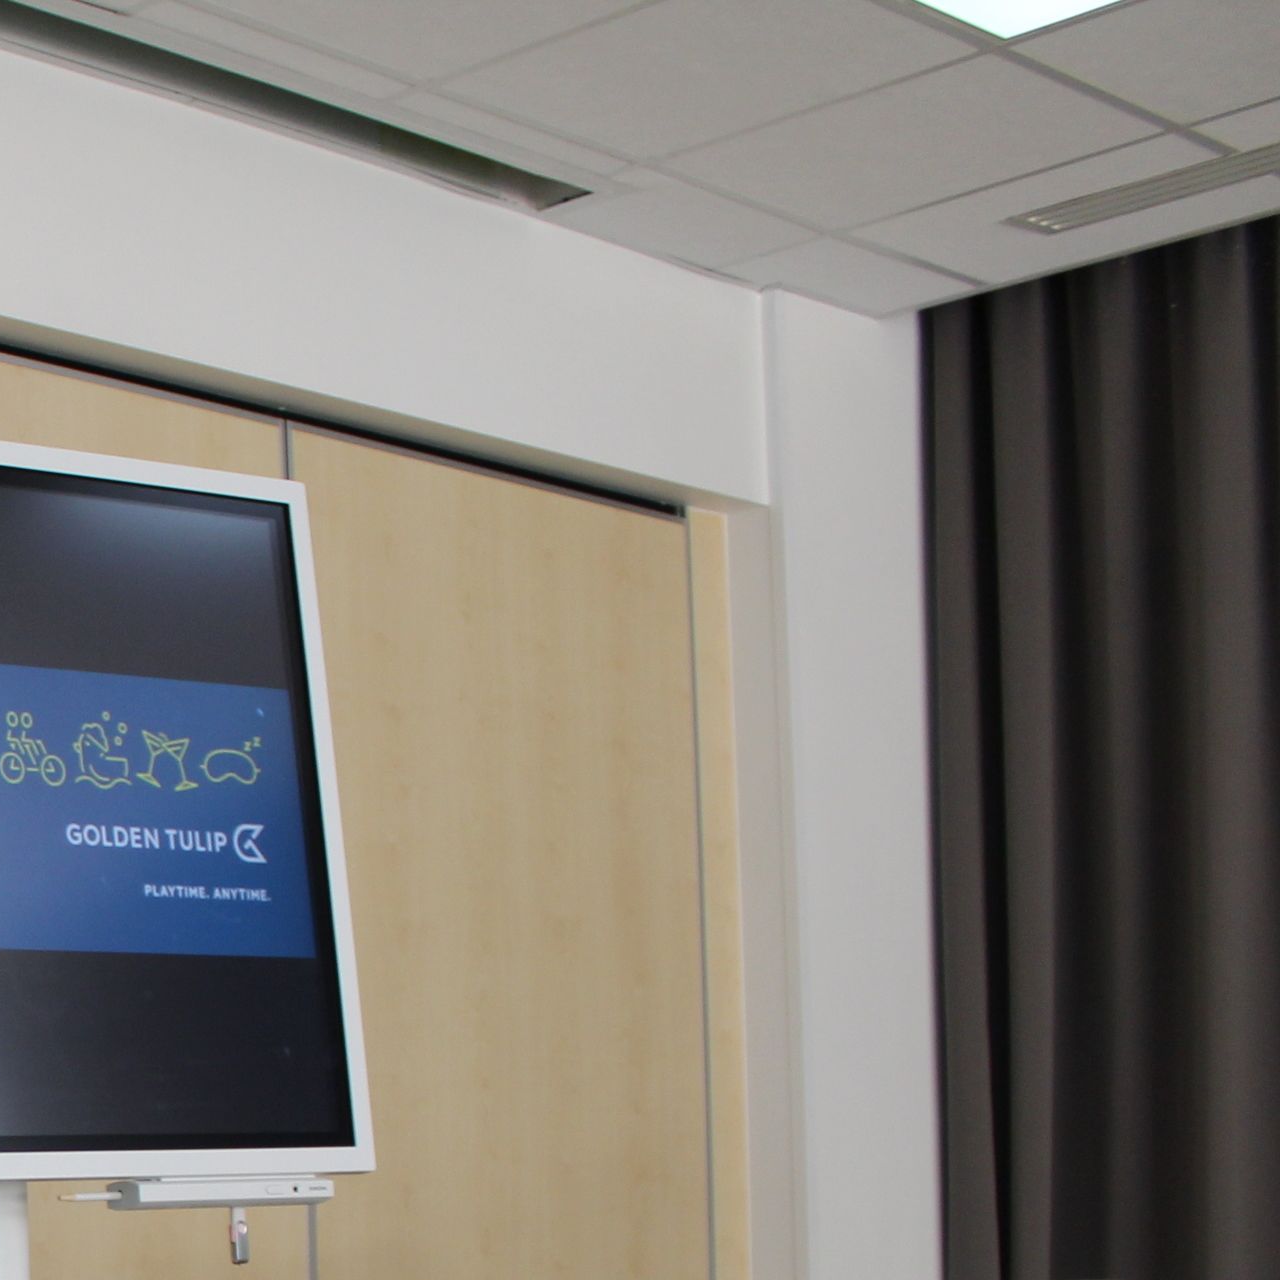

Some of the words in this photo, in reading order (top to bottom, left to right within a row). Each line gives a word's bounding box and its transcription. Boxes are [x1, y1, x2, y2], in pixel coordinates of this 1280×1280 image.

[65, 823, 160, 849] GOLDEN
[164, 829, 228, 852] TULIP
[144, 884, 209, 899] PLAYTIME.
[213, 887, 271, 901] ANYTIME.
